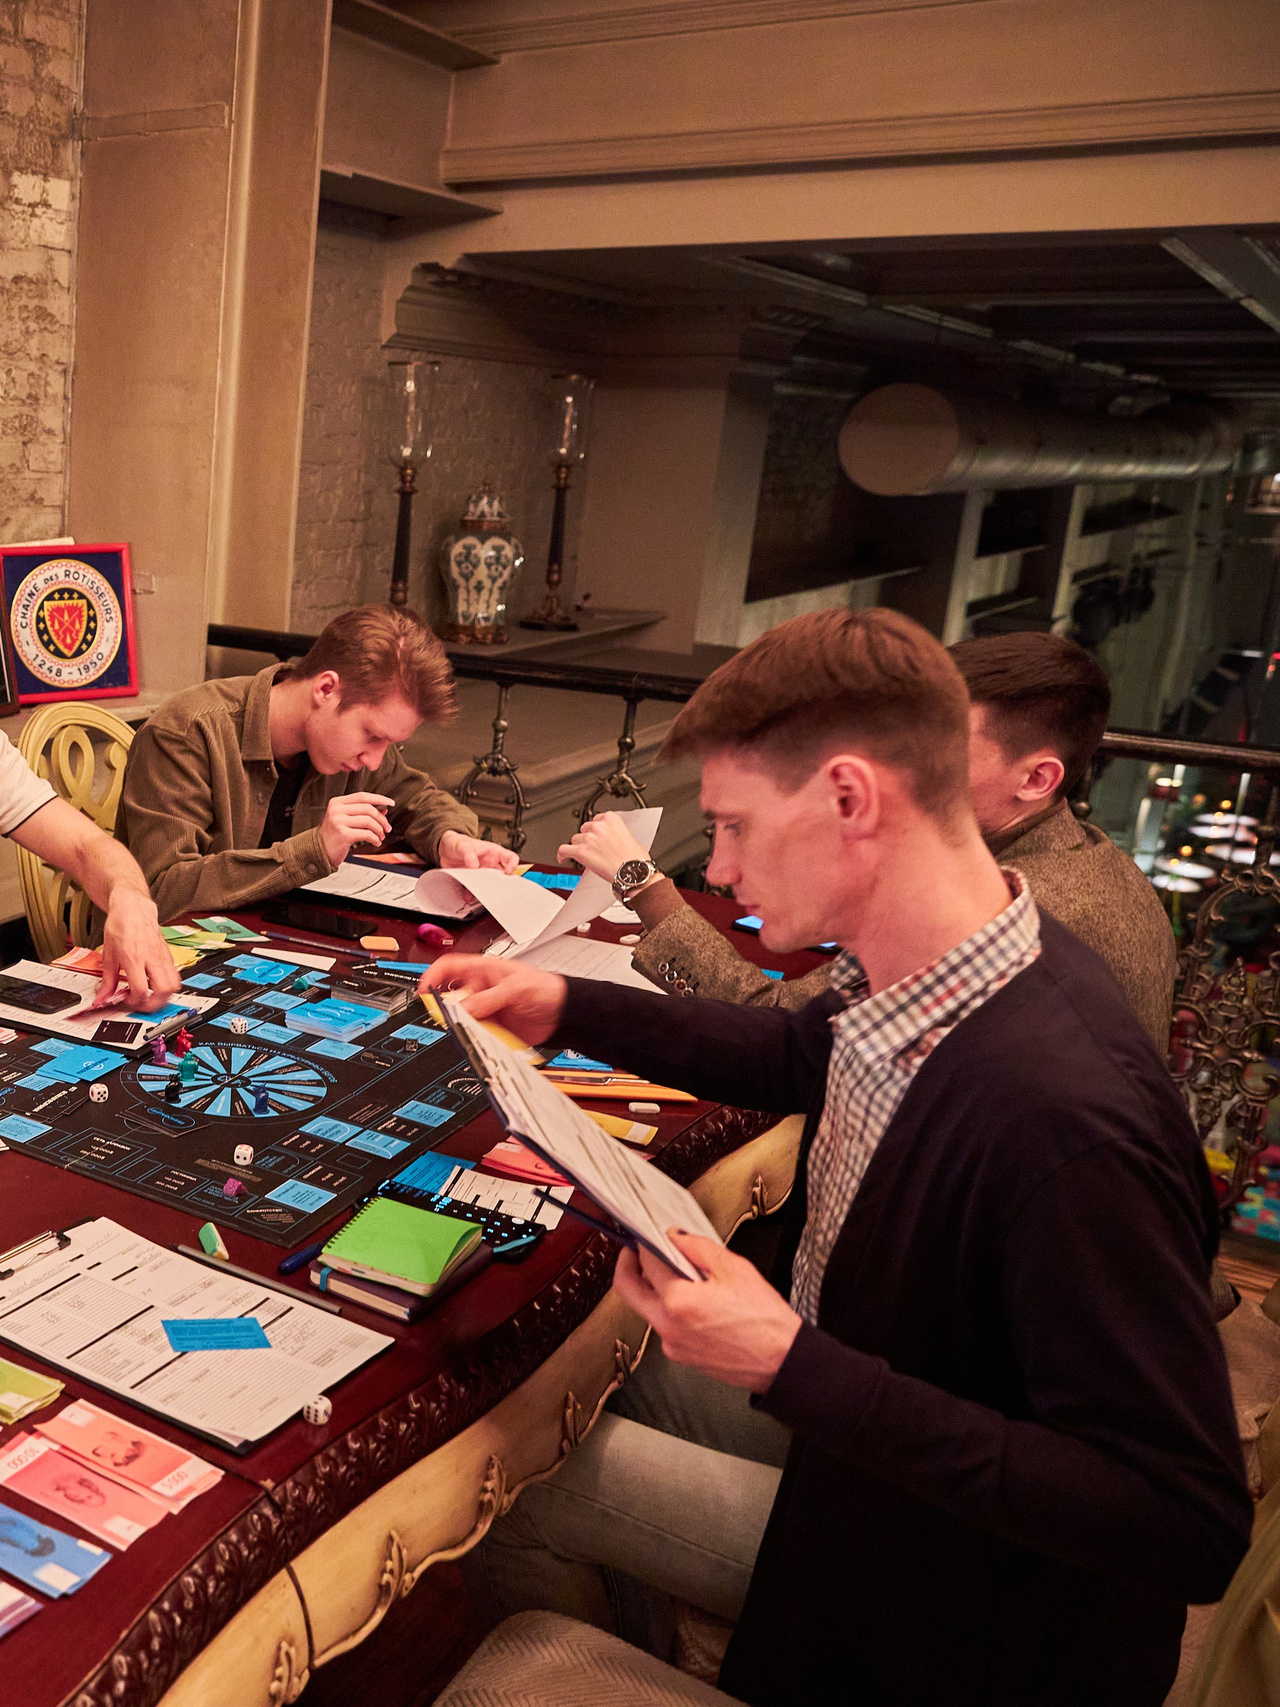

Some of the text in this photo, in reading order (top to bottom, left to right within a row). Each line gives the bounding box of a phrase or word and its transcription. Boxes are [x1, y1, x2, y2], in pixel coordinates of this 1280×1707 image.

[20, 583, 41, 629] CHAINE
[64, 570, 113, 623] ROTISSEURS
[32, 652, 104, 677] 1248 1950
